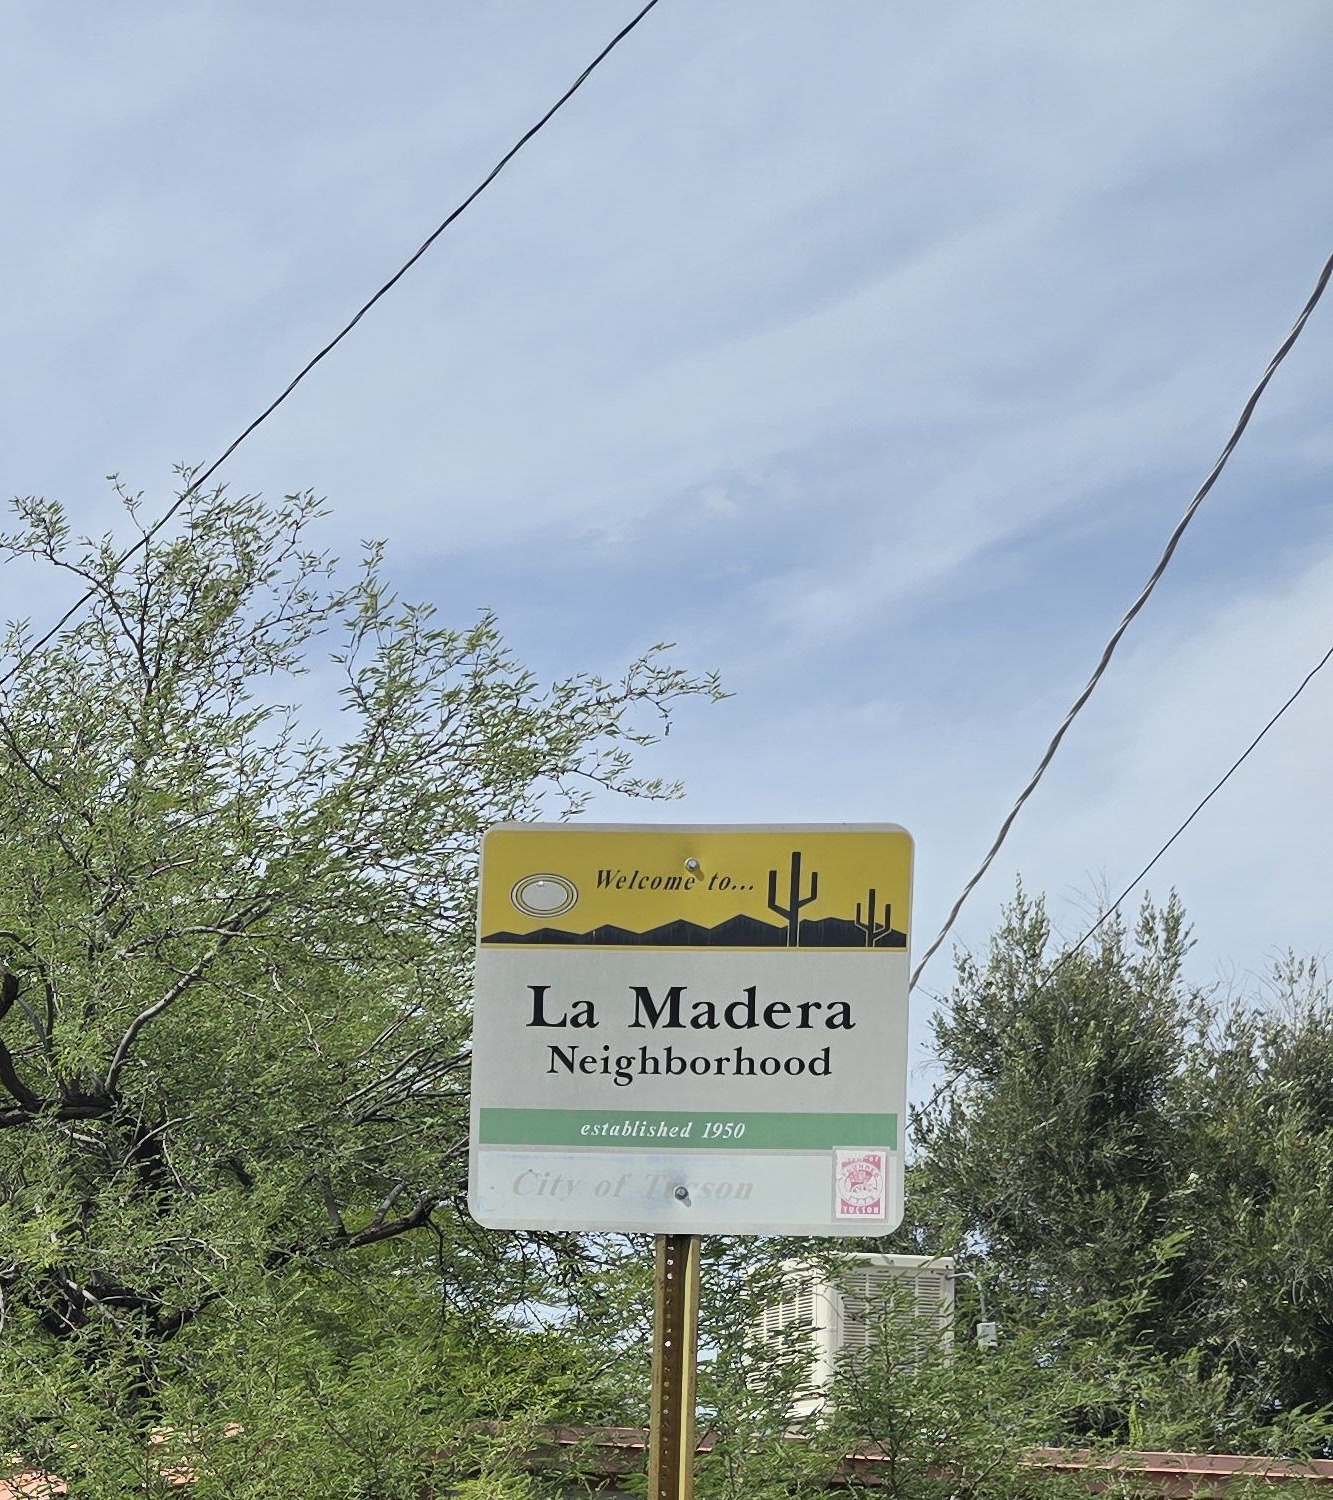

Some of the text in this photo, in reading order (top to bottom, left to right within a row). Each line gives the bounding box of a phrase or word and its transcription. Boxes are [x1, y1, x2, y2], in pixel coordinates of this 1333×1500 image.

[595, 869, 755, 891] Welcome to...
[525, 984, 857, 1031] La Madera
[545, 1043, 833, 1087] Neighborhood
[579, 1119, 747, 1140] established 1950
[511, 1169, 582, 1202] City
[594, 1172, 632, 1198] of
